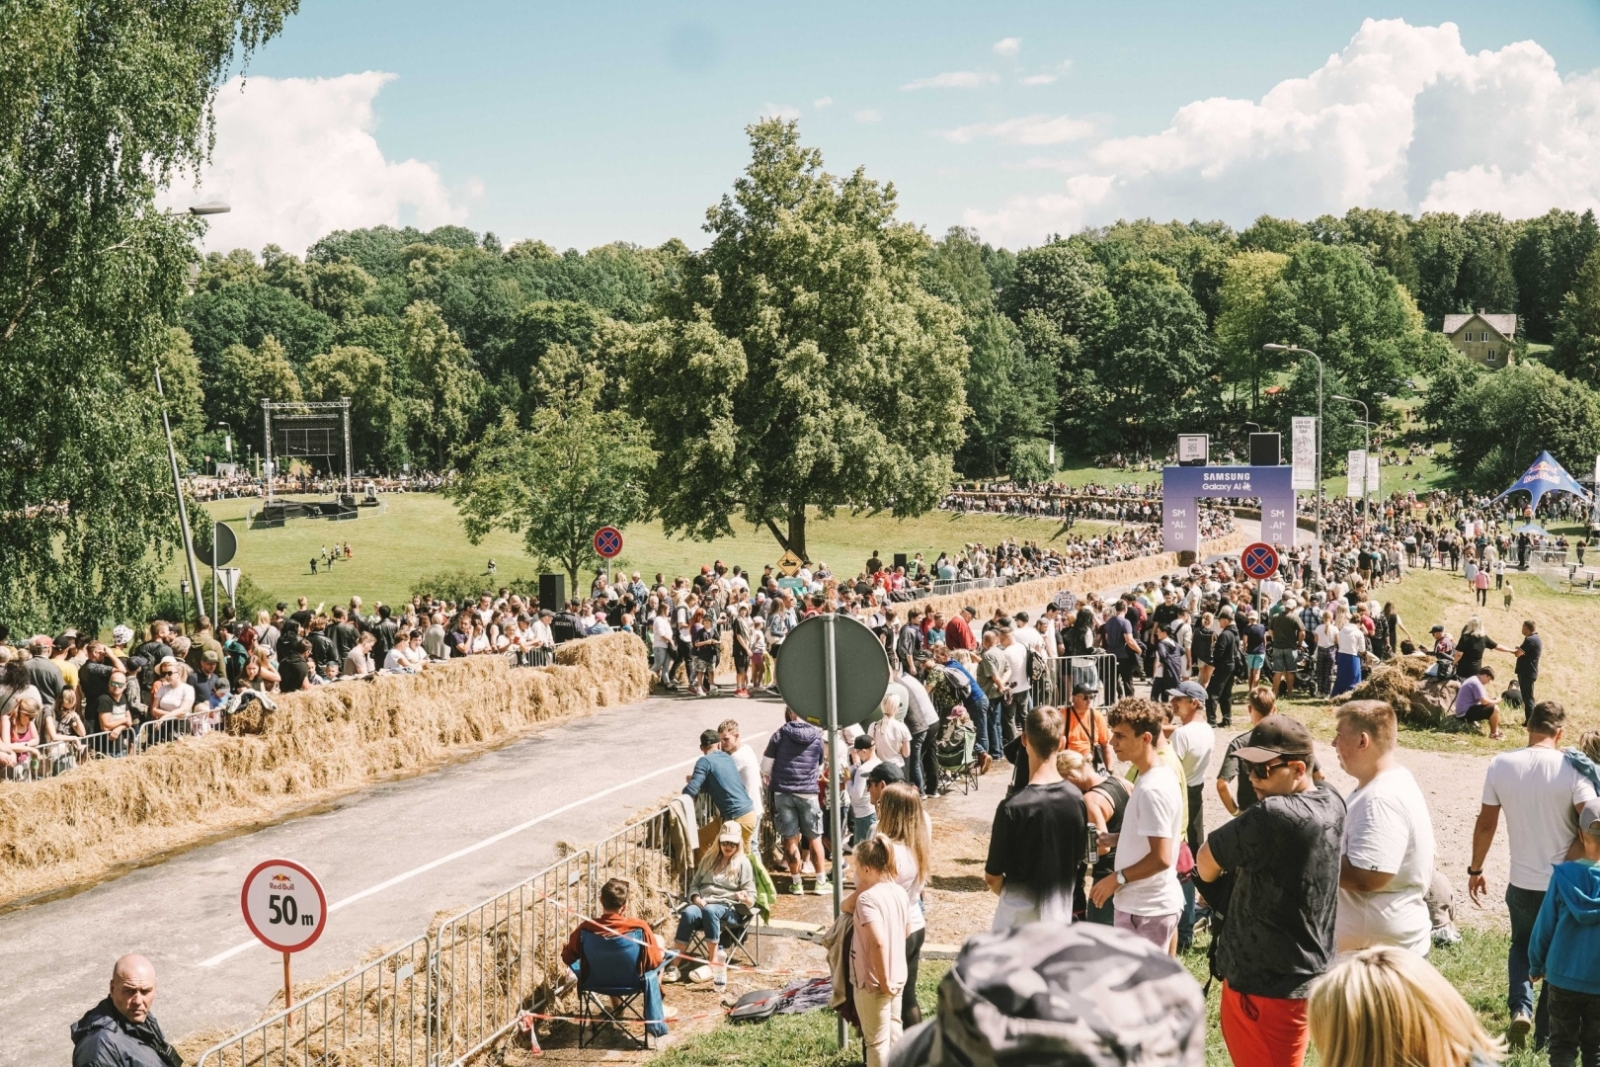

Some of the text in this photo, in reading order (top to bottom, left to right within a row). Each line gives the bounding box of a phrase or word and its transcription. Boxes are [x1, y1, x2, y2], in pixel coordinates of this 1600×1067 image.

[1203, 473, 1250, 481] SAMSUNG
[1202, 483, 1232, 492] Galaxy
[1172, 509, 1186, 517] SM
[1270, 509, 1284, 517] SM
[1175, 532, 1184, 540] DI
[1272, 533, 1282, 541] DI
[270, 882, 295, 891] Red Bull
[269, 894, 313, 926] 50 m
